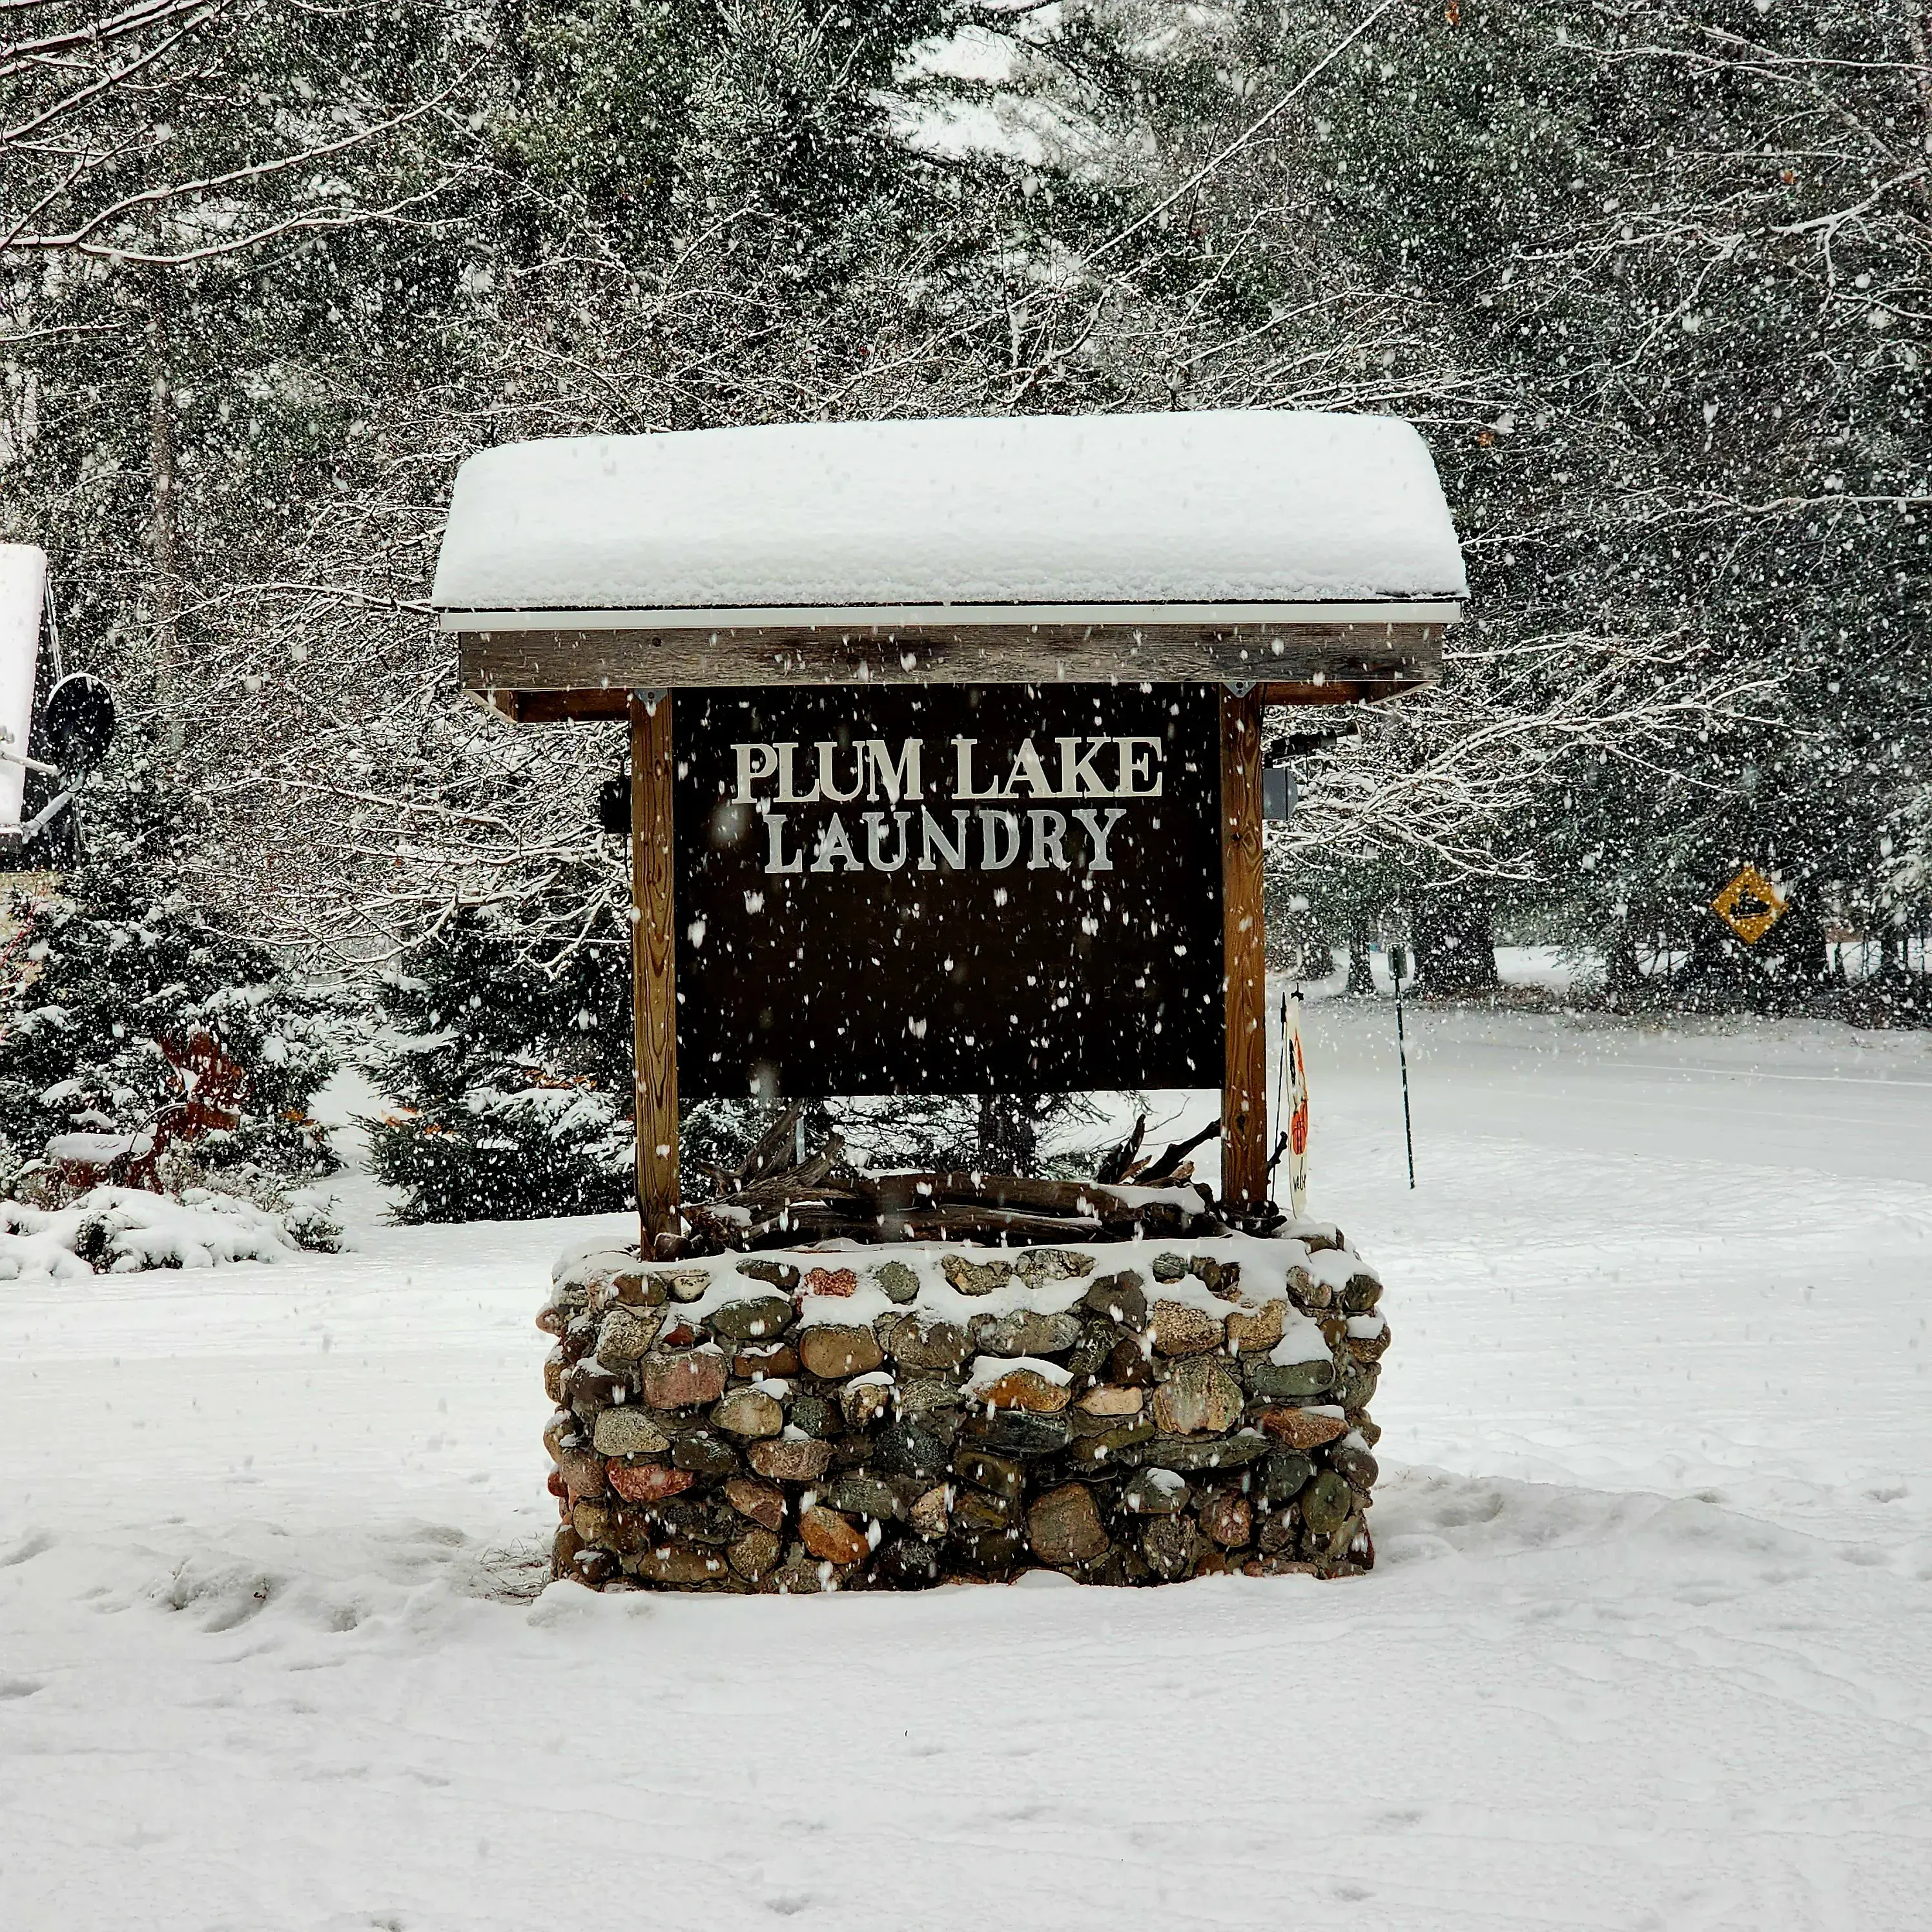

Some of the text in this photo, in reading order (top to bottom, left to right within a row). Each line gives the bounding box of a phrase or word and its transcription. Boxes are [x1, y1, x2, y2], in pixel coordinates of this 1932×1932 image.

[730, 737, 1162, 804] PLUM LAKE
[763, 808, 1127, 874] LAUNDRY
